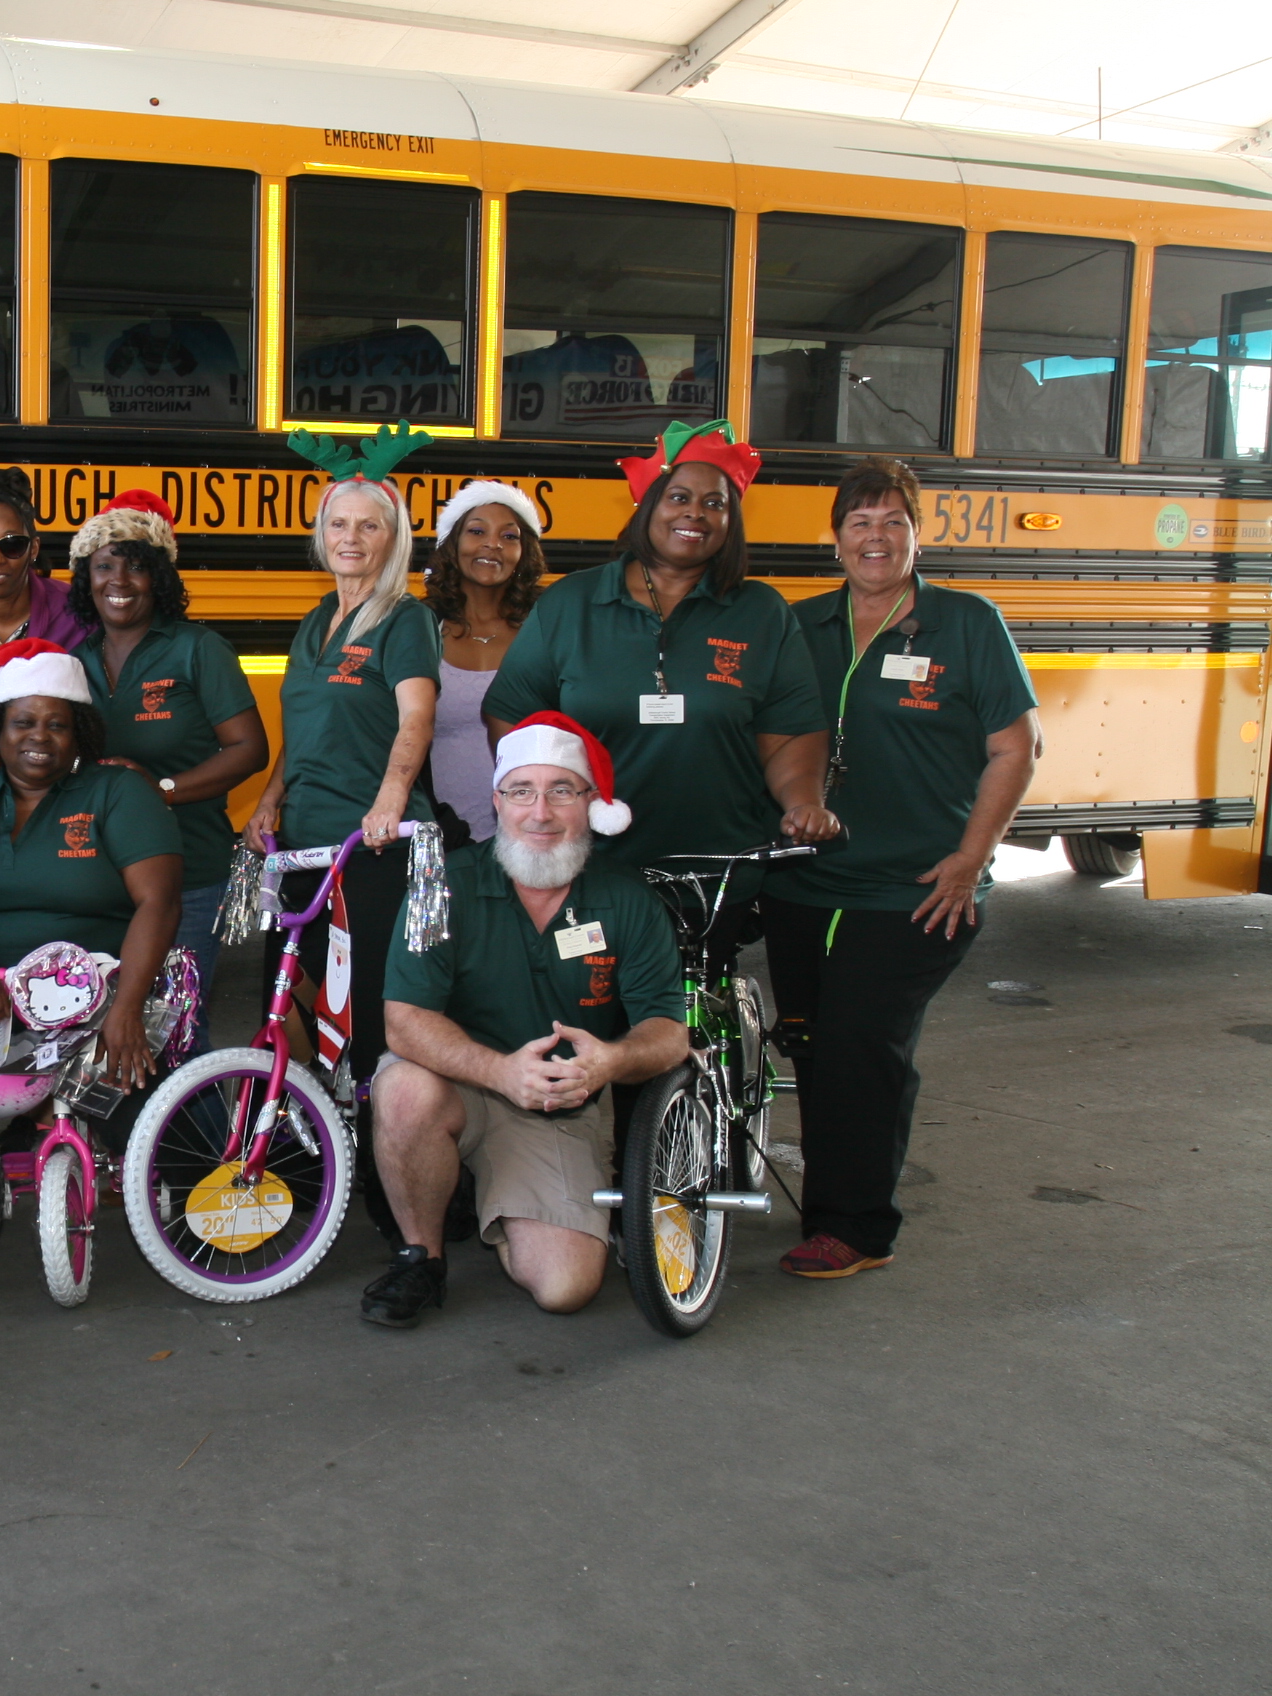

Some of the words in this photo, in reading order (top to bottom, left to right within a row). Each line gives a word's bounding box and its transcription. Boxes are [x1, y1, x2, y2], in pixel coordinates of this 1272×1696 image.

[324, 129, 402, 151] EMERGENCY
[408, 135, 435, 154] EXIT
[161, 470, 328, 530] DISTRIC
[933, 494, 1009, 544] 5341
[1157, 519, 1185, 534] PROPANE
[1213, 527, 1238, 537] BLUE
[1241, 527, 1266, 538] BIRD
[706, 637, 749, 650] MAGNET
[341, 645, 373, 657] MAGNET
[142, 679, 175, 690] MAGNET
[327, 674, 364, 686] CHEETAHS
[898, 697, 940, 711] CHEETAHS
[134, 711, 172, 721] CHEETAHS
[58, 813, 96, 824] MAGNET
[57, 847, 98, 858] CHEETAHS
[221, 1191, 257, 1207] KIDS
[202, 1215, 235, 1236] 20"
